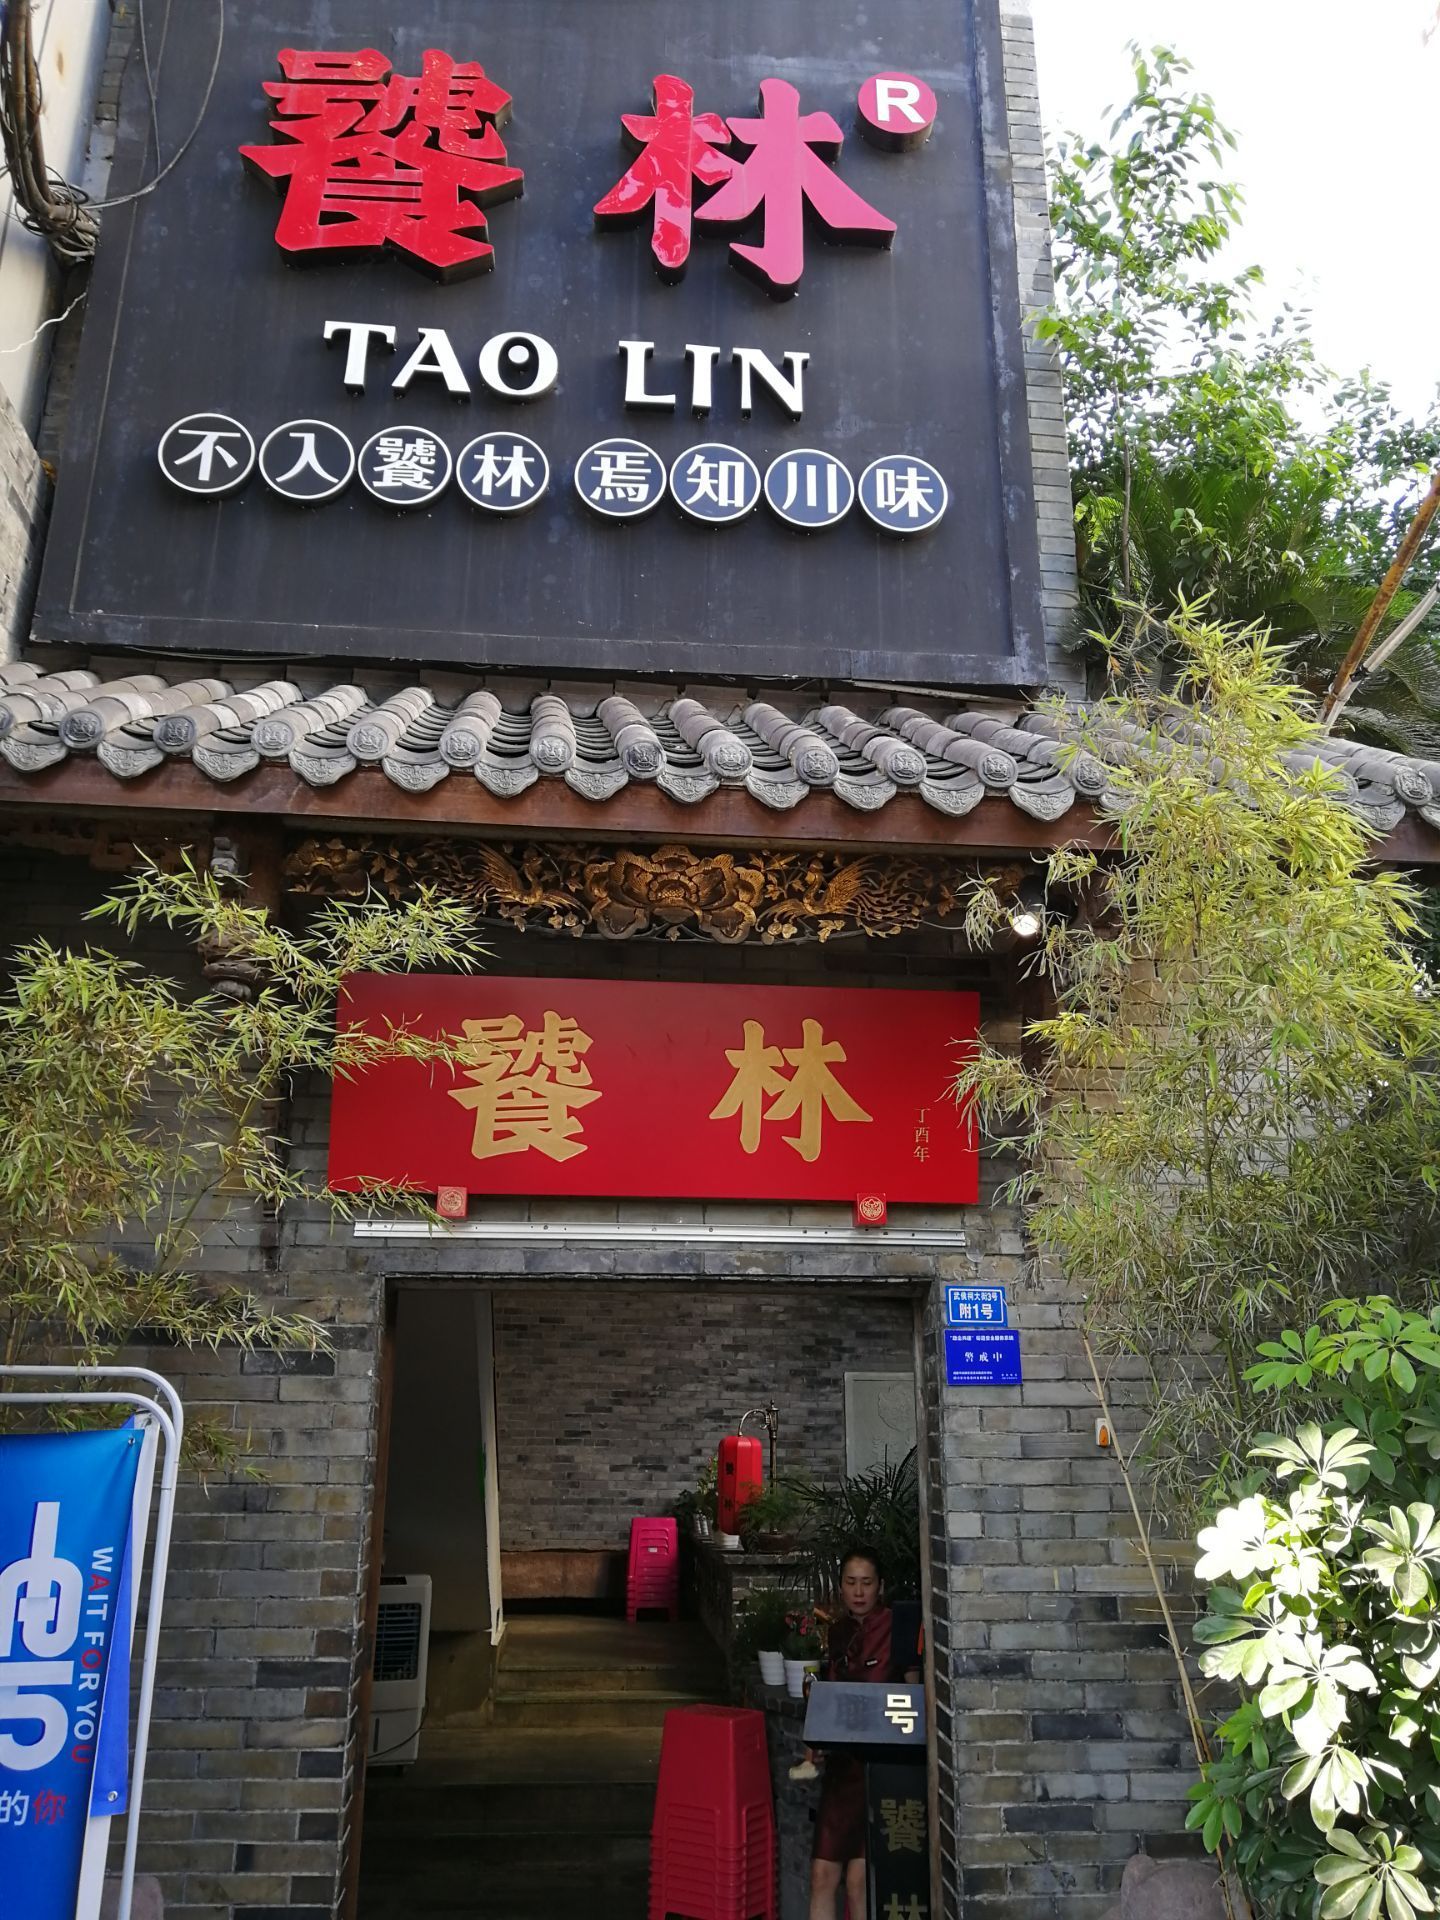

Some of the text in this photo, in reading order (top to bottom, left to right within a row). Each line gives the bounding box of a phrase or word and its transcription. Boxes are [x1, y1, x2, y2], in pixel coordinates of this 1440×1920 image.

[323, 320, 811, 419] TAO LIN
[590, 449, 934, 519] 焉知川味
[913, 1107, 931, 1162] 丁酉年
[959, 1303, 994, 1320] 附1号
[71, 1547, 114, 1764] WAIT FOR YOU
[884, 1694, 919, 1734] 号
[0, 1787, 67, 1826] 的你
